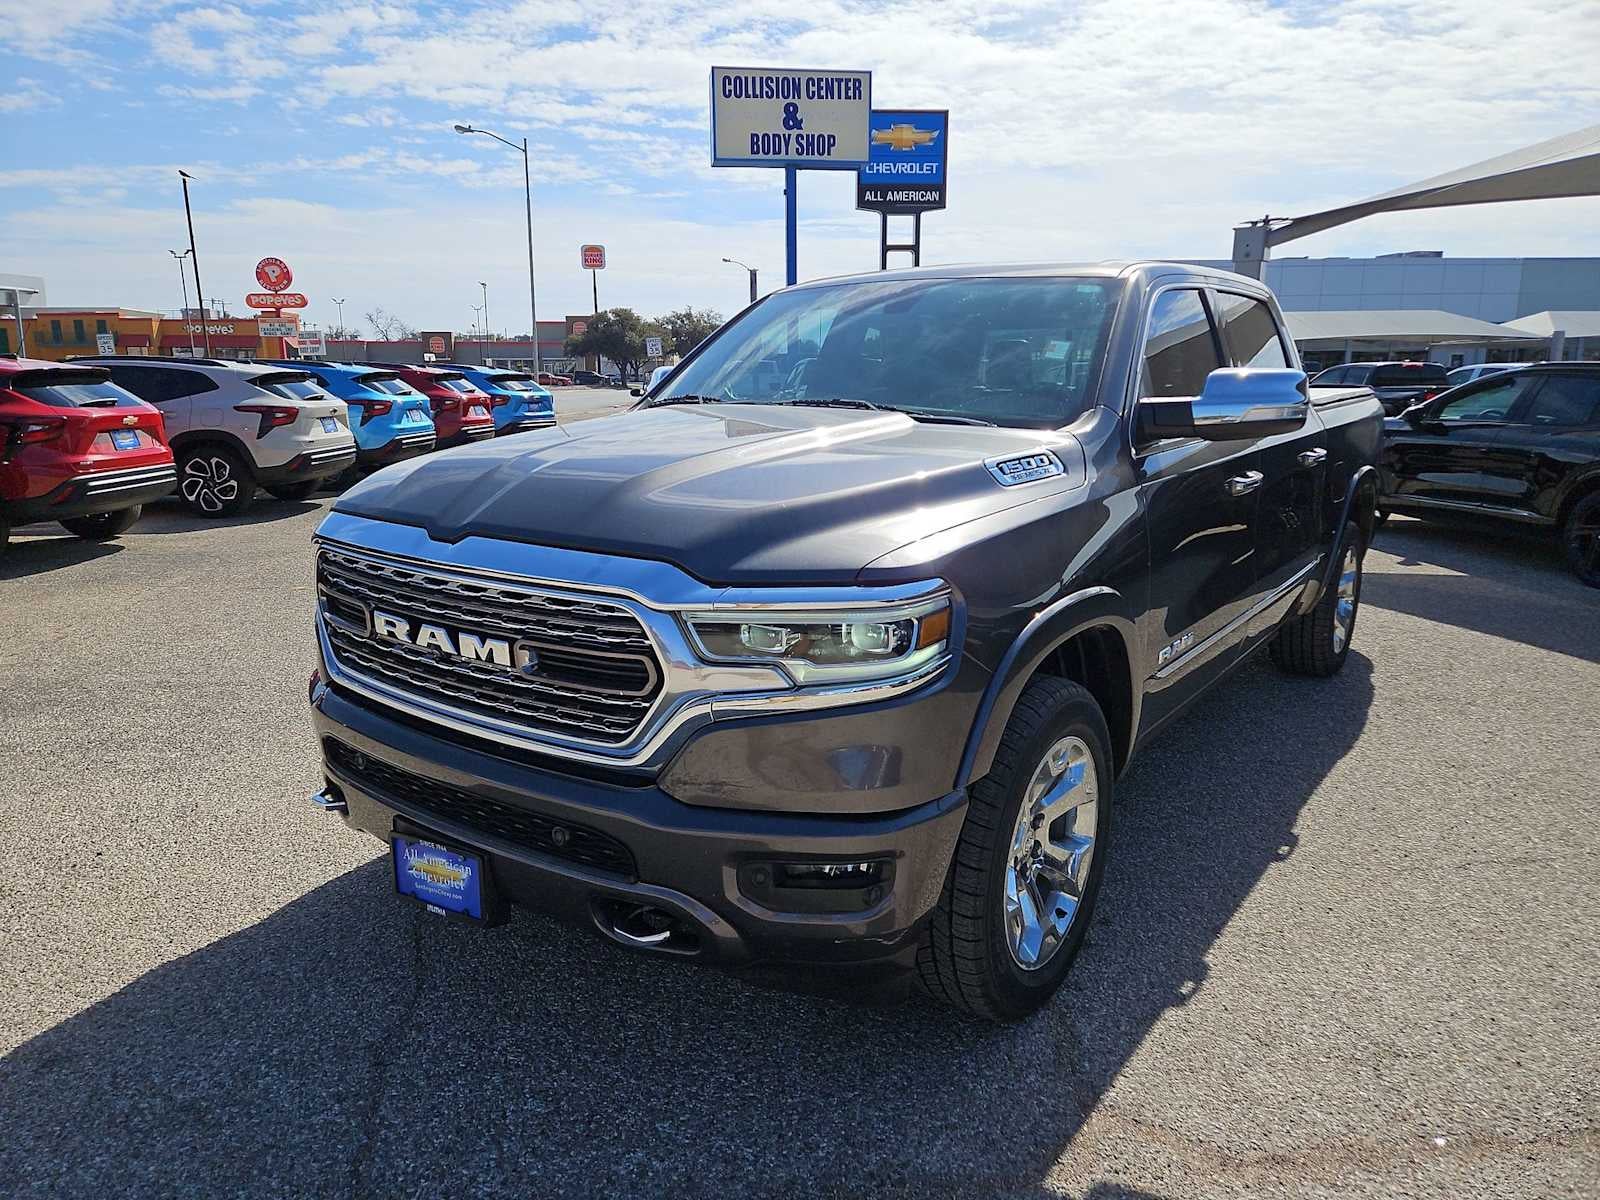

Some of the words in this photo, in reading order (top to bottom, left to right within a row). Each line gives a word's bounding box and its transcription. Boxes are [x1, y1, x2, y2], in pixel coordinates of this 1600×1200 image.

[722, 75, 801, 100] COLLISION
[805, 77, 862, 101] CENTER
[782, 102, 804, 131] &
[750, 133, 793, 156] BODY
[795, 134, 836, 156] SHOP
[865, 162, 939, 174] CHEVROLET
[864, 191, 884, 201] ALL
[886, 191, 940, 201] AMERICAN
[100, 345, 113, 353] 35
[649, 347, 660, 355] 35
[998, 455, 1050, 474] 1500
[373, 609, 511, 667] RAM
[1158, 631, 1195, 665] RAM
[422, 852, 472, 877] American
